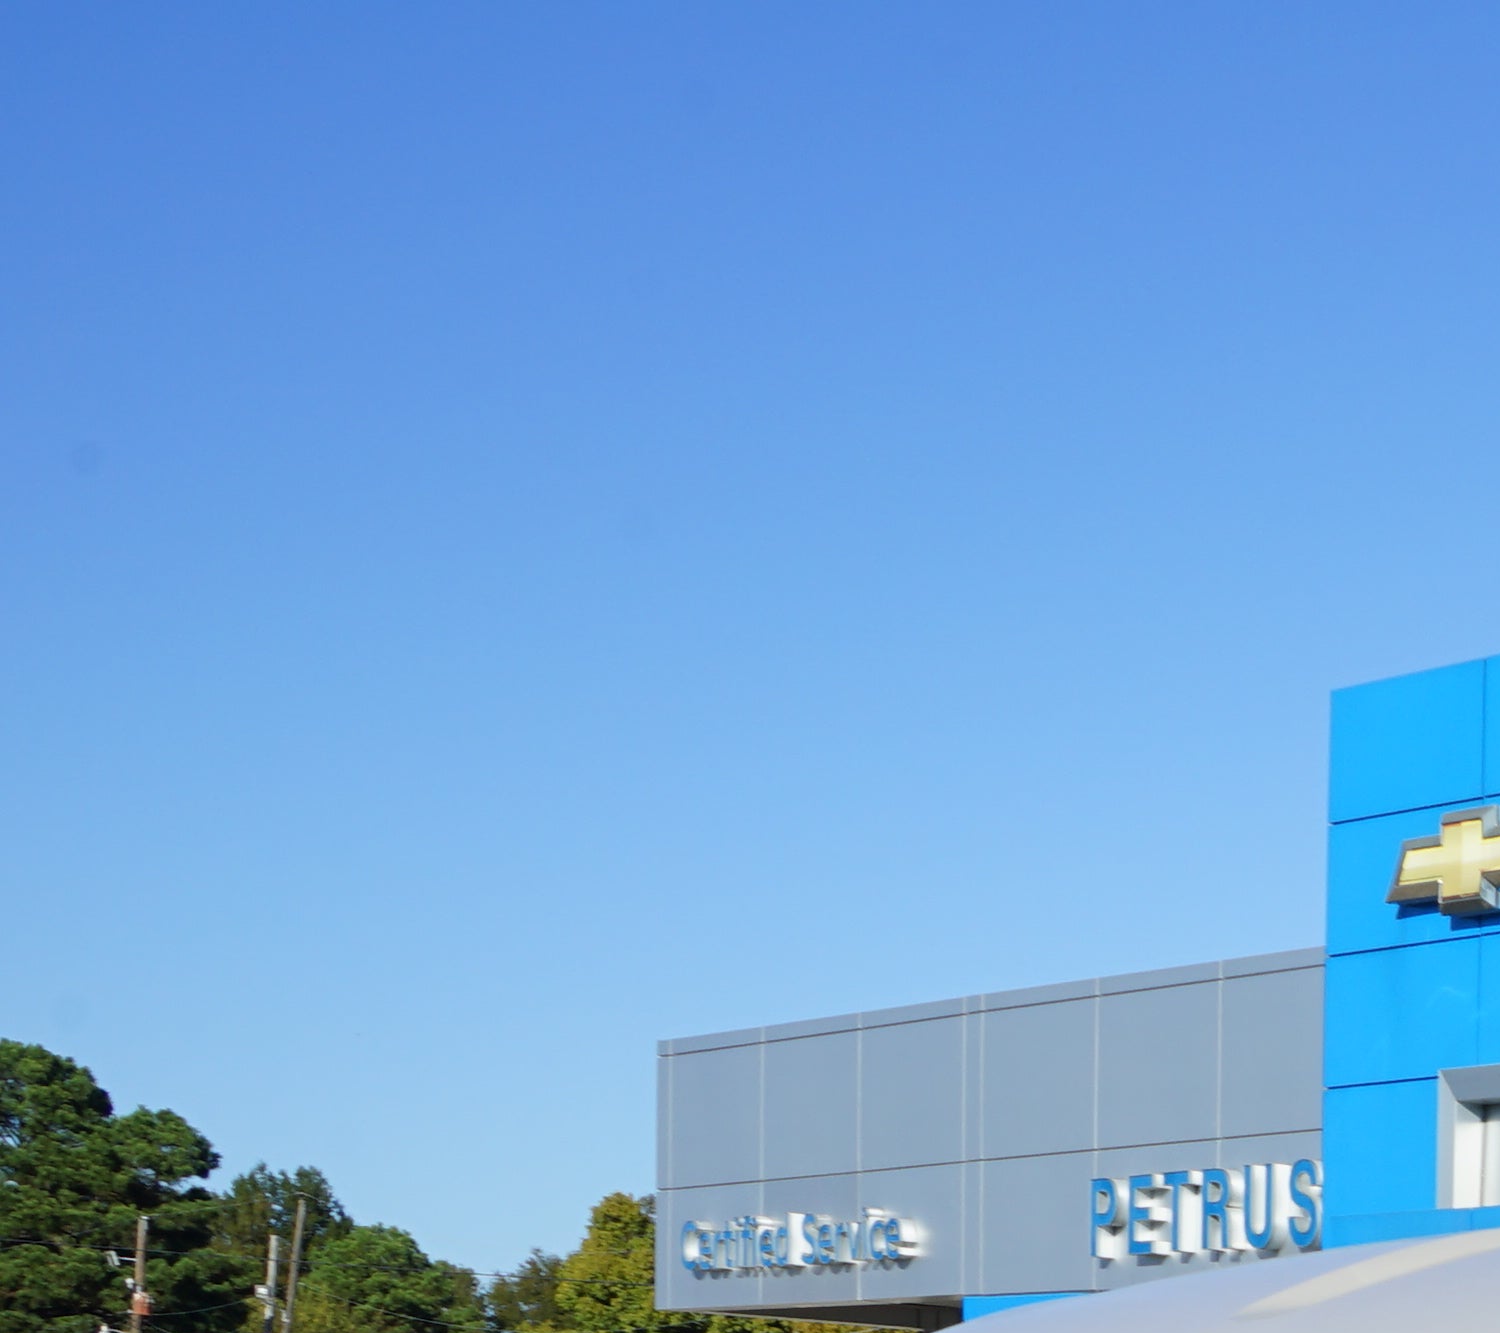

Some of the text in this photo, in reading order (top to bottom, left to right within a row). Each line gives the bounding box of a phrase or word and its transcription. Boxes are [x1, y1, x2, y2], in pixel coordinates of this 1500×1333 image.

[682, 1208, 908, 1271] Certified Service
[1091, 1159, 1322, 1257] PETRUS
